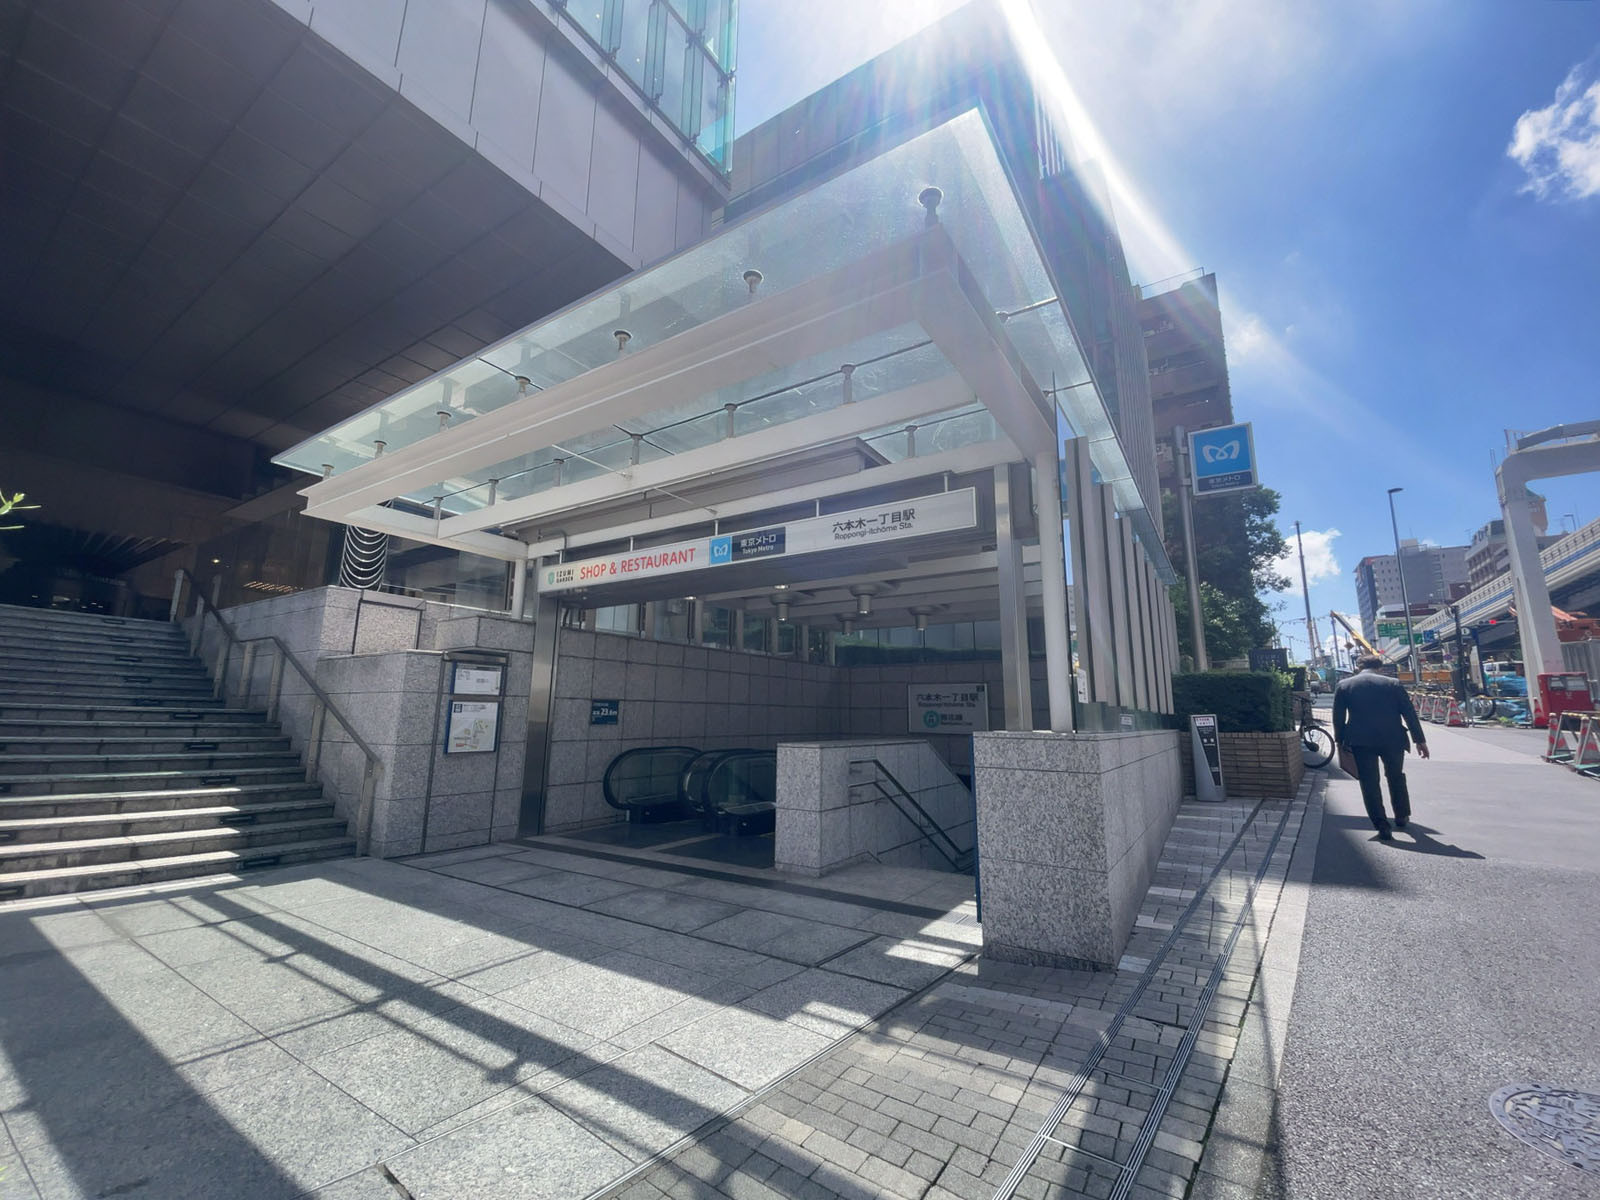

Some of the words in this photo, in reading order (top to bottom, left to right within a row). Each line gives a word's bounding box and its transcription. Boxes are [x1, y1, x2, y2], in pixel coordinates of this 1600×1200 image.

[833, 508, 916, 533] 六本木一丁目駅
[899, 521, 914, 531] Sta.
[741, 533, 777, 548] 東京メトロ
[742, 546, 757, 556] Tokyo
[757, 544, 774, 553] Metro
[580, 563, 607, 580] SHOP
[609, 561, 617, 575] &
[620, 547, 696, 573] RESTAURANT
[556, 568, 574, 578] IZUMI
